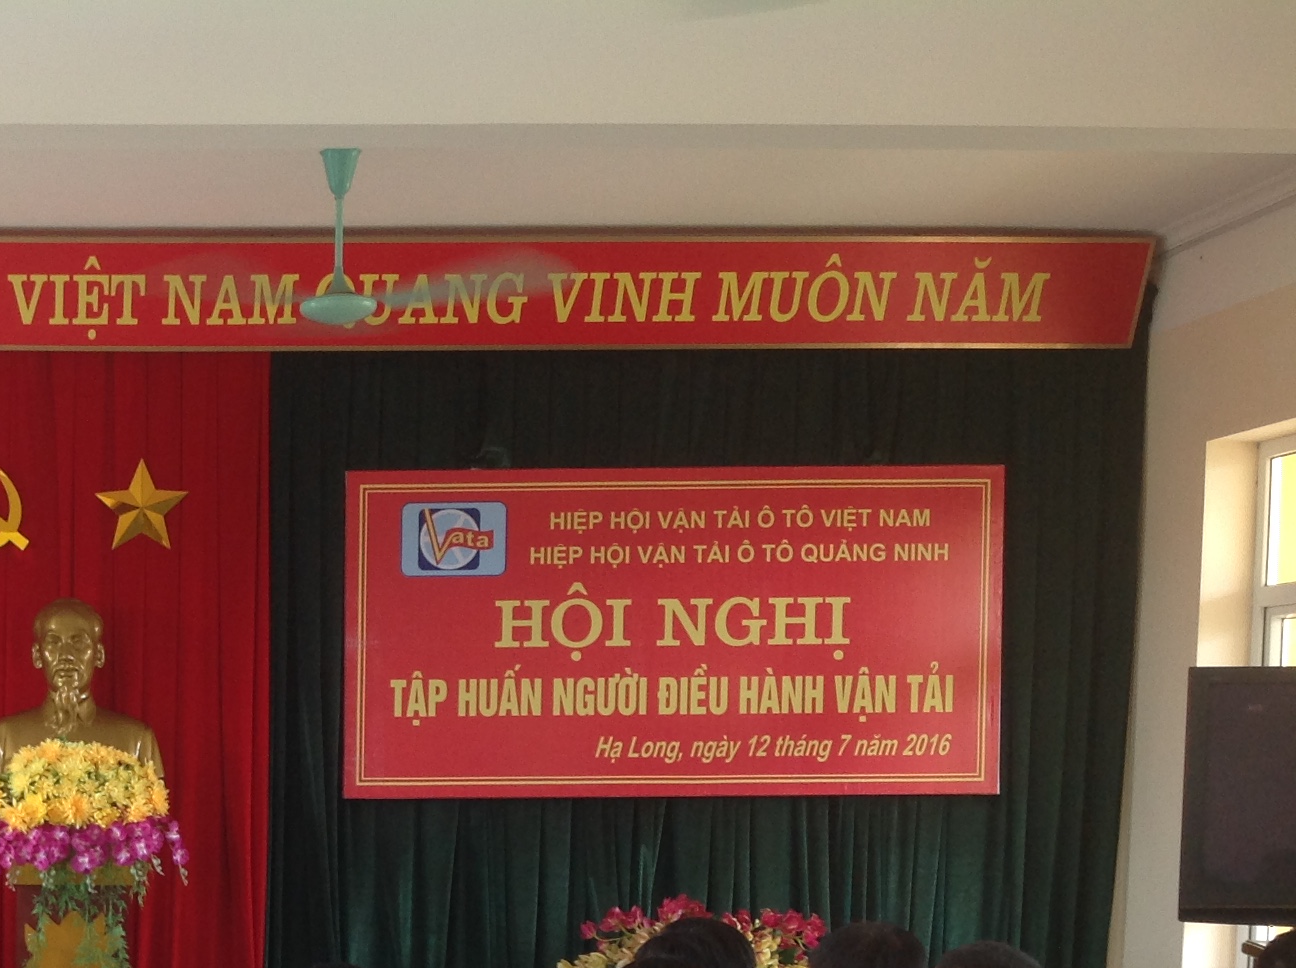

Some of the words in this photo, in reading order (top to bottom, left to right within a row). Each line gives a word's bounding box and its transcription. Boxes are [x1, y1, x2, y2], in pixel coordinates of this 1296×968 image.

[8, 256, 146, 340] VIỆT
[161, 273, 300, 325] NAM
[546, 272, 697, 324] VINH
[712, 254, 897, 322] MUÔN
[907, 257, 1050, 322] NĂM
[550, 508, 603, 534] HIỆP
[610, 508, 650, 534] HỘI
[657, 508, 706, 533] VẬN
[713, 506, 750, 529] TẢI
[757, 505, 775, 528] Ô
[781, 504, 814, 528] TÔ
[820, 506, 872, 532] VIỆT
[879, 508, 931, 527] NAM
[530, 544, 583, 569] HIỆP
[590, 543, 630, 569] HỘI
[637, 543, 686, 568] VẬN
[693, 541, 730, 564] TẢI
[737, 539, 755, 563] Ô
[762, 539, 794, 563] TÔ
[800, 539, 887, 563] QUẢNG
[893, 543, 950, 562] NINH
[495, 582, 632, 661] HỘI
[657, 597, 851, 660] NGHỊ
[390, 671, 447, 726] TẬP
[458, 664, 542, 717] HUẤN
[553, 668, 647, 716] NGƯỜI
[657, 664, 728, 715] ĐIỀU
[739, 667, 824, 714] HÀNH
[835, 667, 896, 722] VẬN
[907, 661, 954, 713] TẢI
[595, 736, 623, 763] Hạ
[628, 737, 682, 763] Long,
[690, 735, 741, 763] ngày
[749, 735, 770, 756] 12
[775, 735, 832, 762] tháng
[839, 735, 852, 756] 7
[854, 734, 898, 756] năm
[902, 733, 952, 756] 2016
